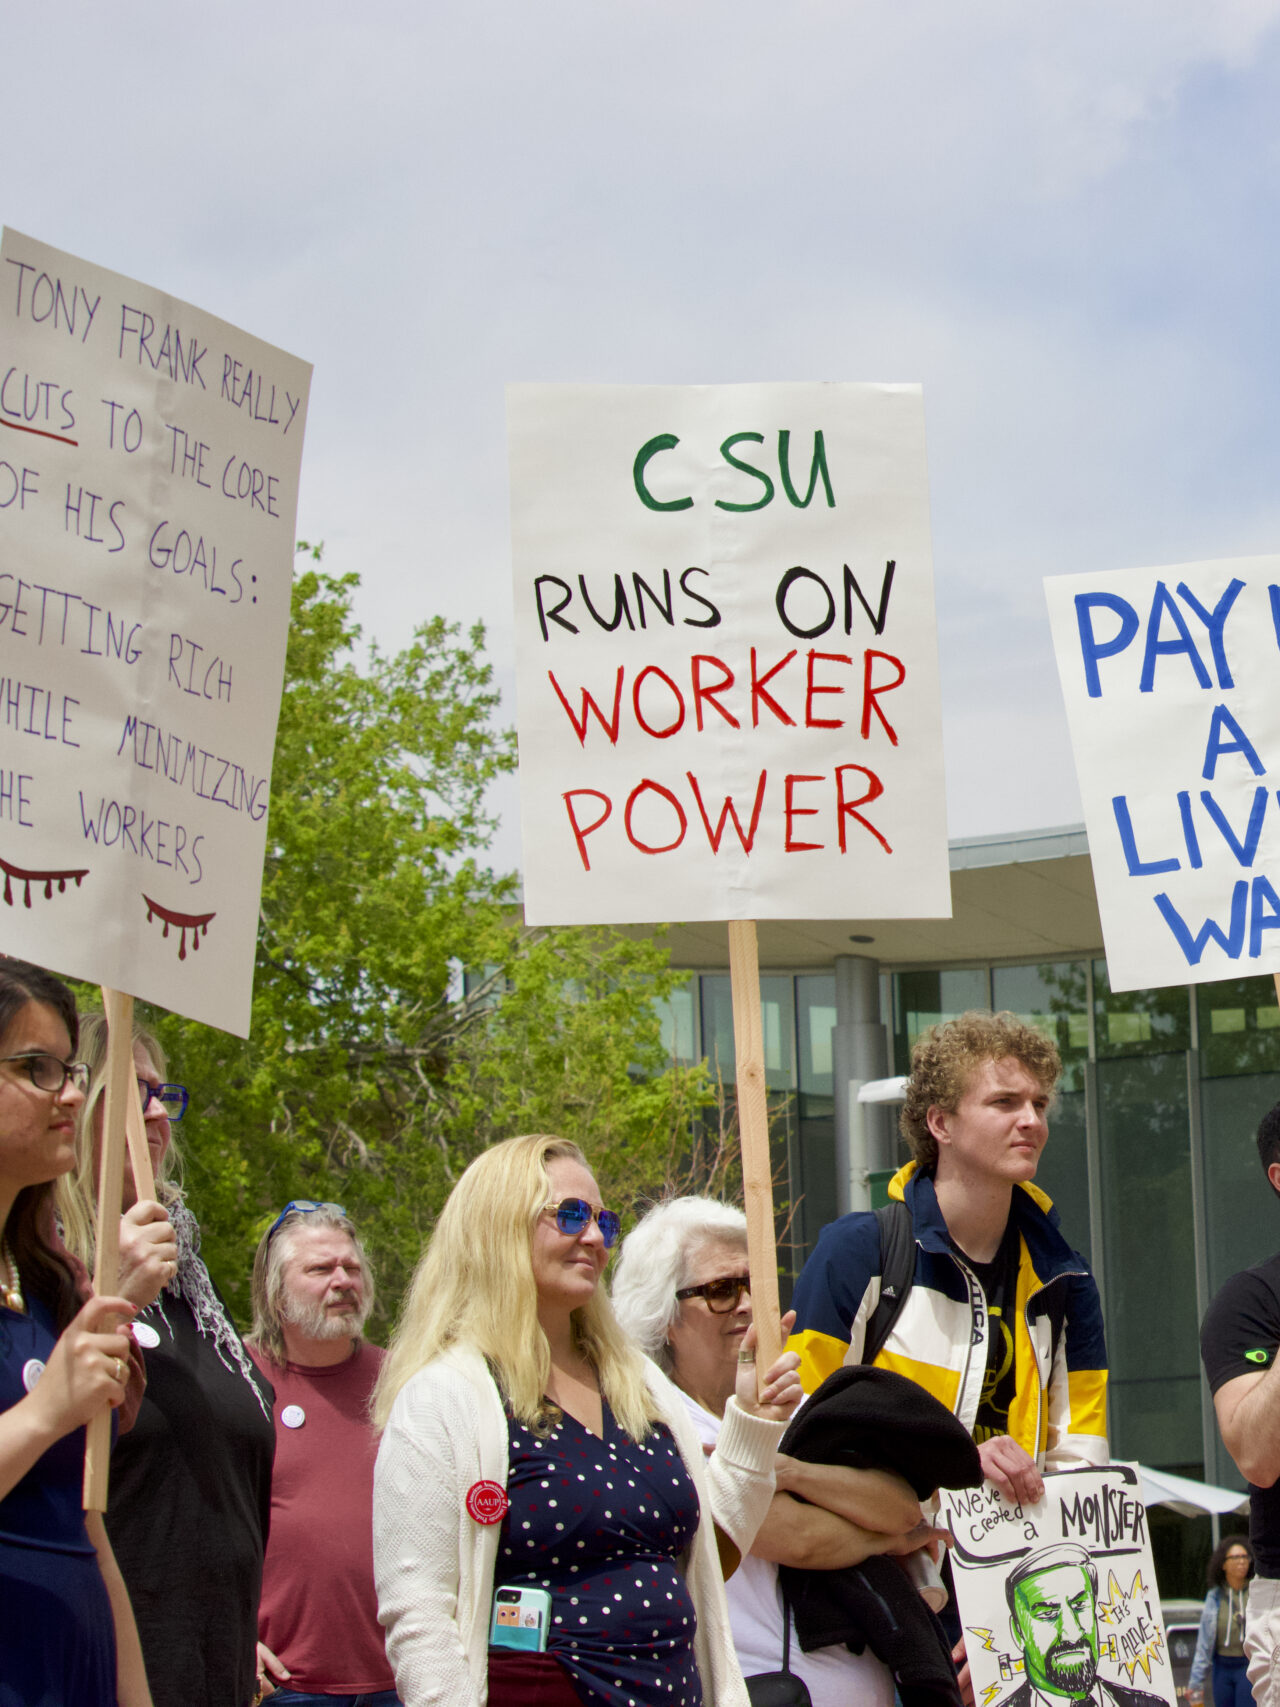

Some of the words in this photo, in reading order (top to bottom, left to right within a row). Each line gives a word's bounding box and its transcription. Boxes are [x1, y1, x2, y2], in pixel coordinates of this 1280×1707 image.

[6, 258, 101, 343] TONY
[119, 304, 208, 390] FRANK
[221, 353, 300, 434] REALLY
[0, 367, 76, 430] CUTS
[101, 400, 143, 453] TO
[165, 424, 211, 489] THE
[222, 455, 280, 518] CORE
[633, 430, 836, 512] CSU
[0, 461, 40, 509] OF
[65, 483, 126, 552] HIS
[149, 520, 257, 603] GOALS:
[534, 566, 722, 641] RUNS
[776, 560, 896, 639] ON
[1074, 578, 1247, 698] PAY
[168, 633, 233, 702] RICH
[548, 646, 906, 748] WORKER
[0, 677, 80, 748] HILE
[118, 715, 268, 822] MINIMIZING
[1202, 703, 1267, 780] A
[0, 769, 34, 828] HE
[79, 790, 205, 885] WORKERS
[561, 764, 893, 871] POWER
[477, 1498, 500, 1506] AAUP
[948, 1487, 1001, 1519] We've
[970, 1499, 1024, 1541] created
[1024, 1521, 1039, 1541] a
[1060, 1484, 1146, 1548] MONSTER
[1111, 1600, 1131, 1624] It's
